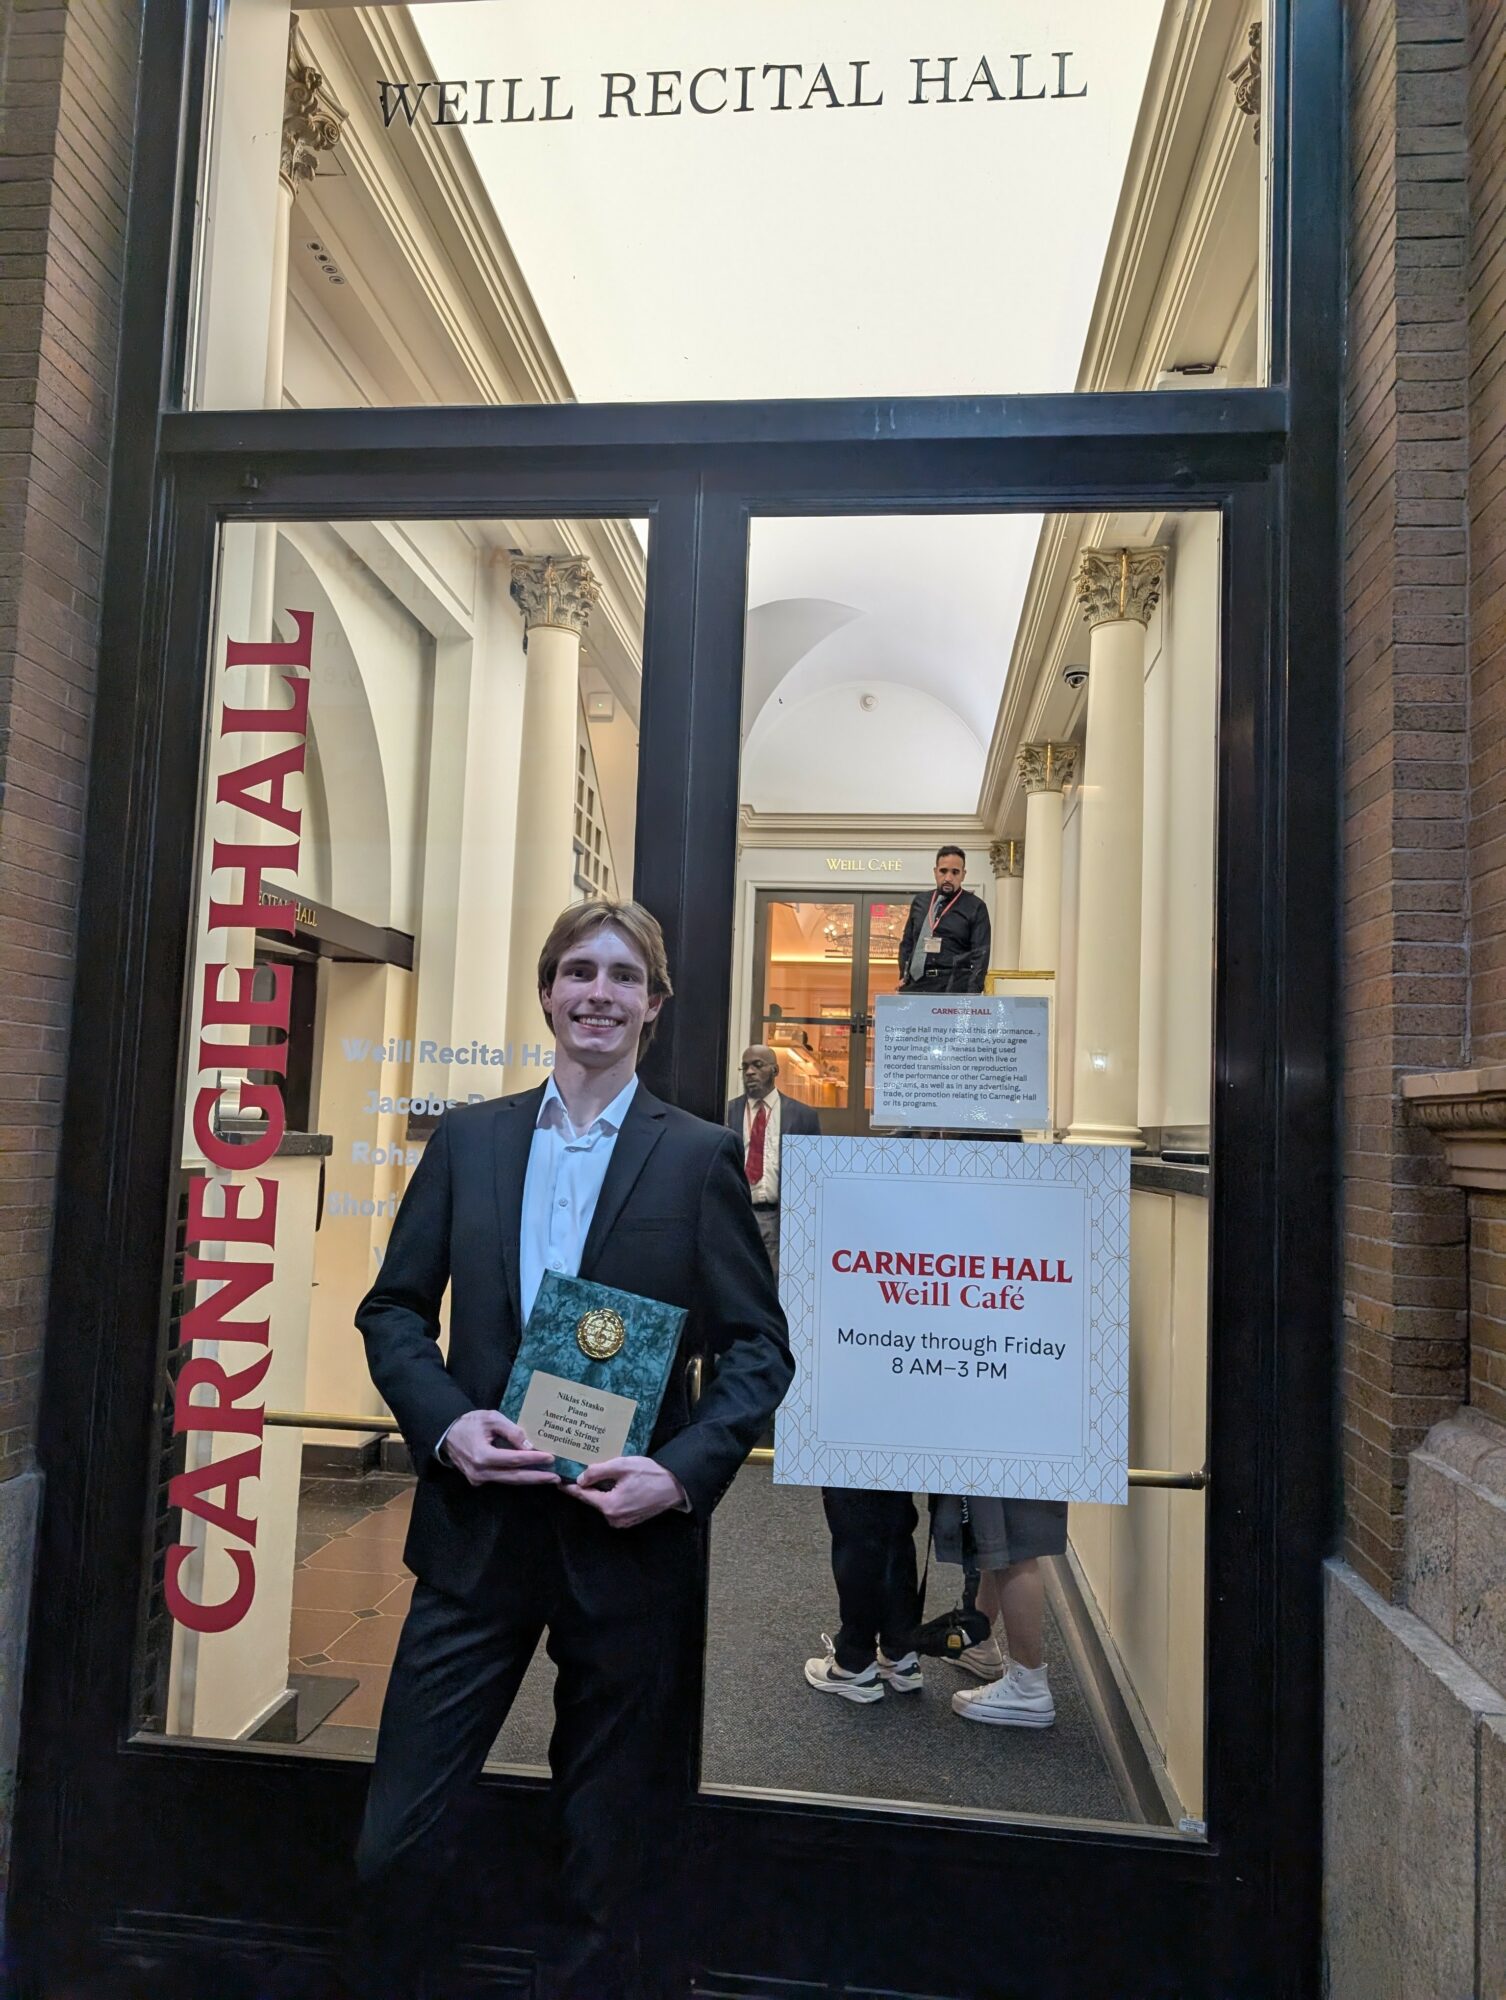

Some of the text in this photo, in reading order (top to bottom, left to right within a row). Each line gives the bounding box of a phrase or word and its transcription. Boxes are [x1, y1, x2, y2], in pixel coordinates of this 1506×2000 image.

[376, 51, 1088, 128] WEILL RECITAL HALL
[931, 1007, 992, 1016] CARNEGIE HALL
[884, 1025, 917, 1035] Carnegie
[932, 1027, 948, 1035] may
[973, 1026, 987, 1034] this
[884, 1034, 894, 1043] By
[895, 1035, 929, 1044] attending
[1007, 1038, 1028, 1046] agree
[341, 1038, 412, 1064] Weill
[419, 1040, 513, 1067] Recital
[892, 1054, 906, 1062] any
[995, 1055, 1009, 1063] live
[893, 1045, 909, 1053] your
[910, 1045, 931, 1054] image
[977, 1046, 998, 1055] being
[998, 1046, 1016, 1054] used
[917, 1063, 961, 1071] transmission
[971, 1064, 1018, 1073] reproduction
[883, 1071, 892, 1079] of
[905, 1072, 950, 1080] performance
[959, 1073, 979, 1081] other
[979, 1074, 1012, 1083] Carnegie
[883, 1090, 904, 1098] trade,
[913, 1091, 951, 1099] promotion
[952, 1091, 979, 1101] relating
[980, 1092, 988, 1100] to
[988, 1093, 1022, 1102] Carnegie
[1022, 1093, 1037, 1101] Hall
[978, 1083, 1021, 1093] advertising,
[892, 1099, 901, 1107] its
[902, 1100, 938, 1109] programs.
[164, 608, 315, 1634] CARNEGIE HALL
[831, 1249, 1073, 1283] CARNEGIE HALL
[877, 1279, 1026, 1311] Weill Café
[837, 1327, 1066, 1361] Monday through Friday
[891, 1357, 904, 1374] 8
[976, 1362, 1008, 1380] PM
[557, 1391, 605, 1412] Niklas Stasko
[567, 1405, 588, 1418] Piano
[544, 1409, 606, 1434] American Protégé
[543, 1420, 564, 1433] Piano
[573, 1429, 600, 1443] Strings
[537, 1428, 601, 1454] Competition 2025
